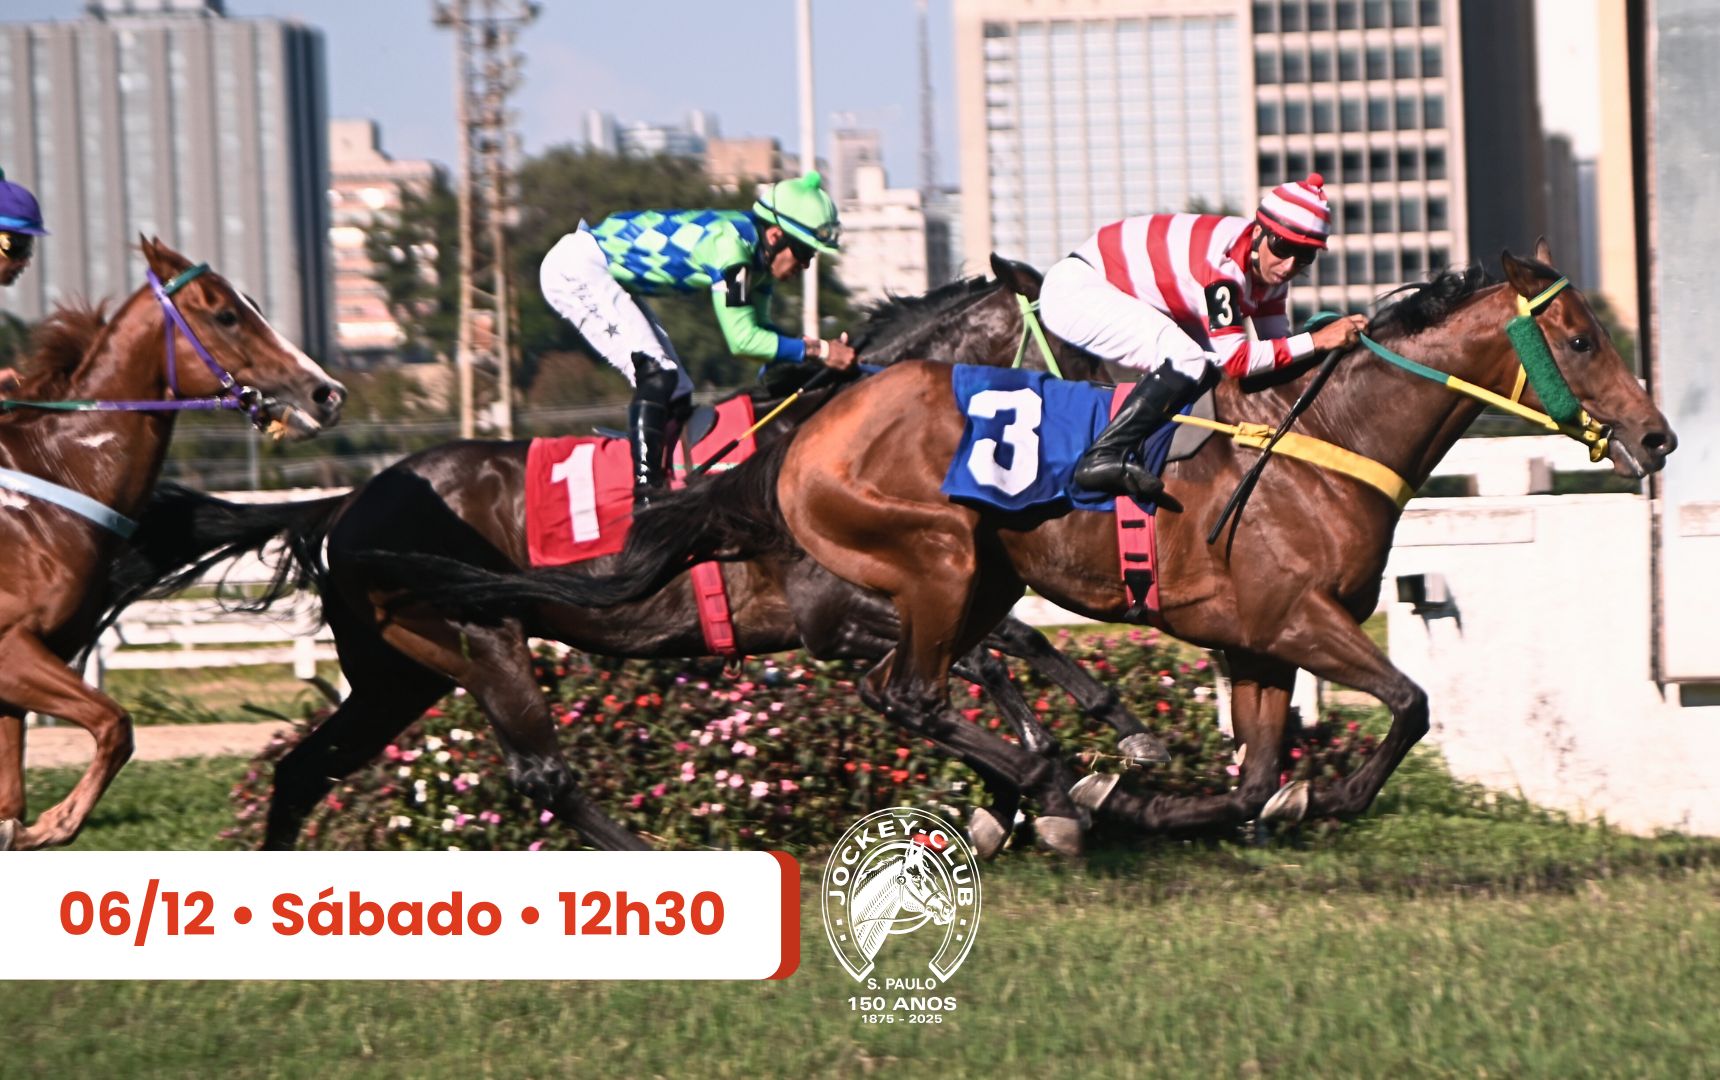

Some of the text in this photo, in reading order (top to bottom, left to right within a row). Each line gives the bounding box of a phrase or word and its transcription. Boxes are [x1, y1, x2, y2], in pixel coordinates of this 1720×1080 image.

[735, 266, 747, 302] 1
[1215, 285, 1233, 326] 3
[967, 387, 1043, 497] 3
[550, 443, 600, 543] 1
